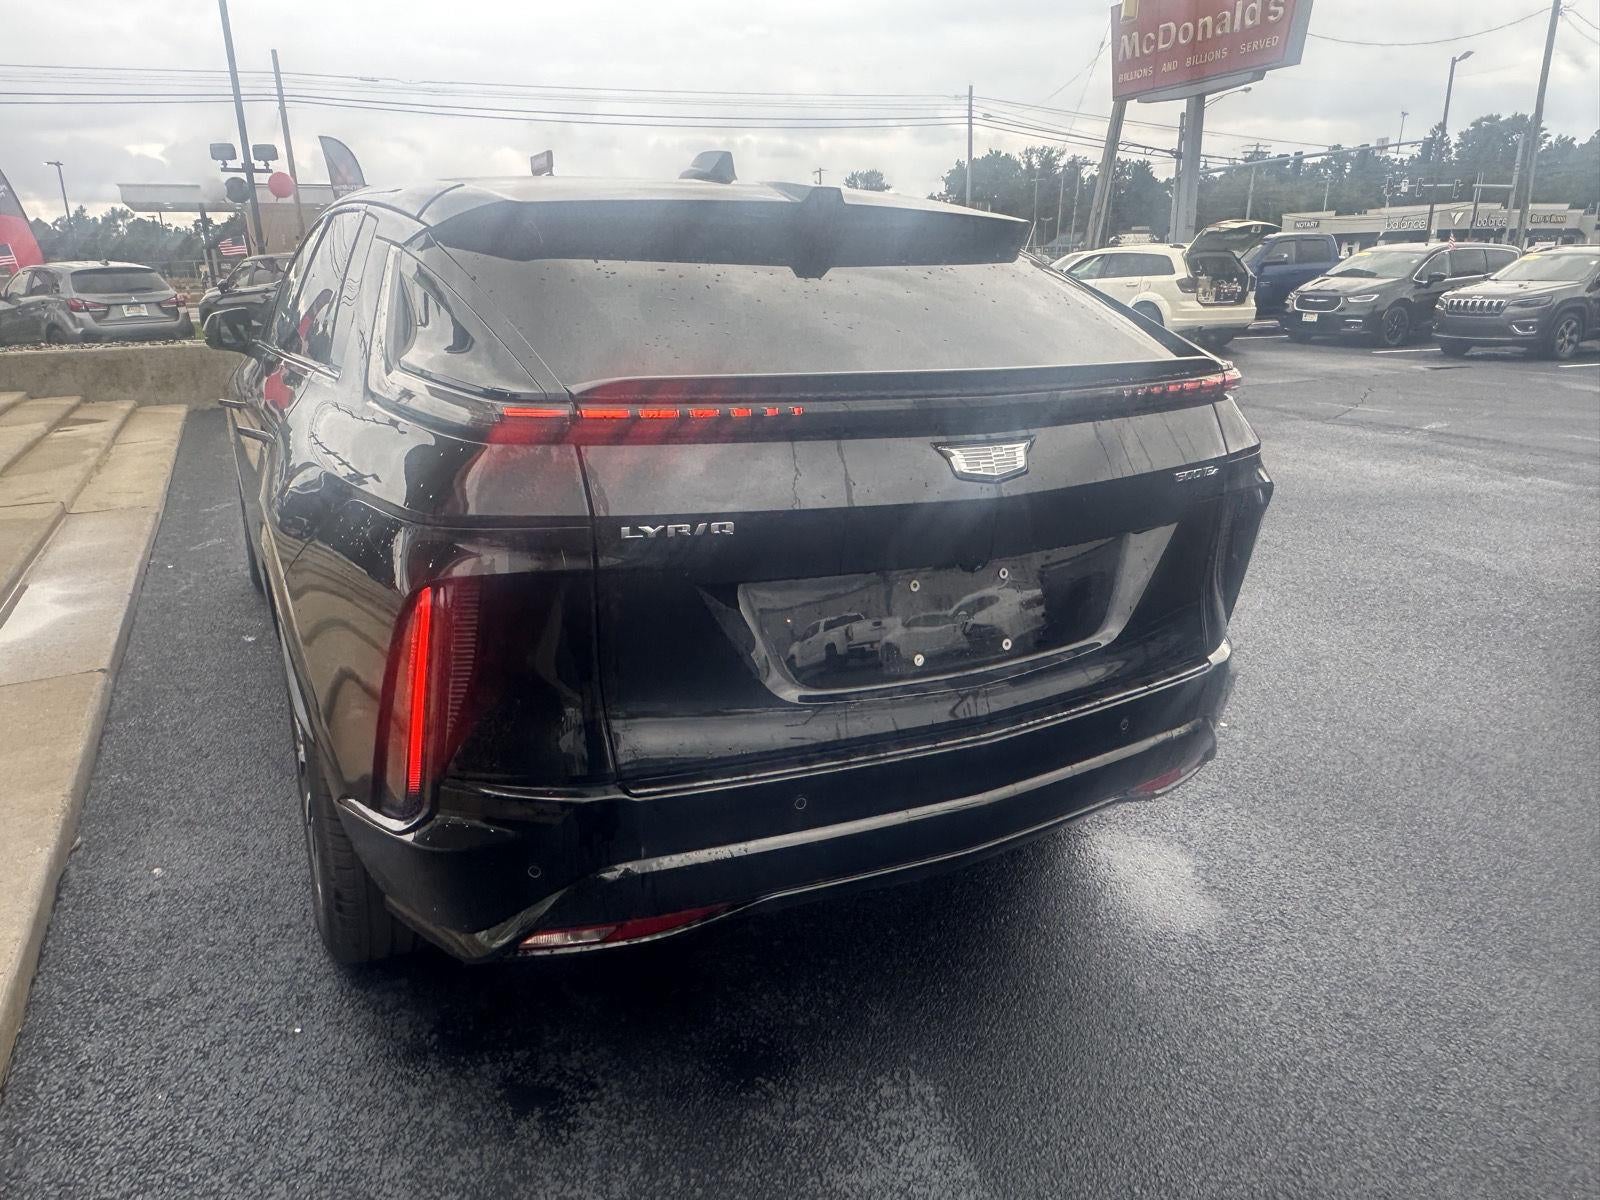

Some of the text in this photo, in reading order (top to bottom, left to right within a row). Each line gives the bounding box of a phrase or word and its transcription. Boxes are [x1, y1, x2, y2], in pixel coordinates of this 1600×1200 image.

[1117, 0, 1284, 62] McDonalds
[1119, 36, 1279, 82] BILLIONS AND BILLIONS SERVED
[1295, 220, 1319, 229] NOTARY
